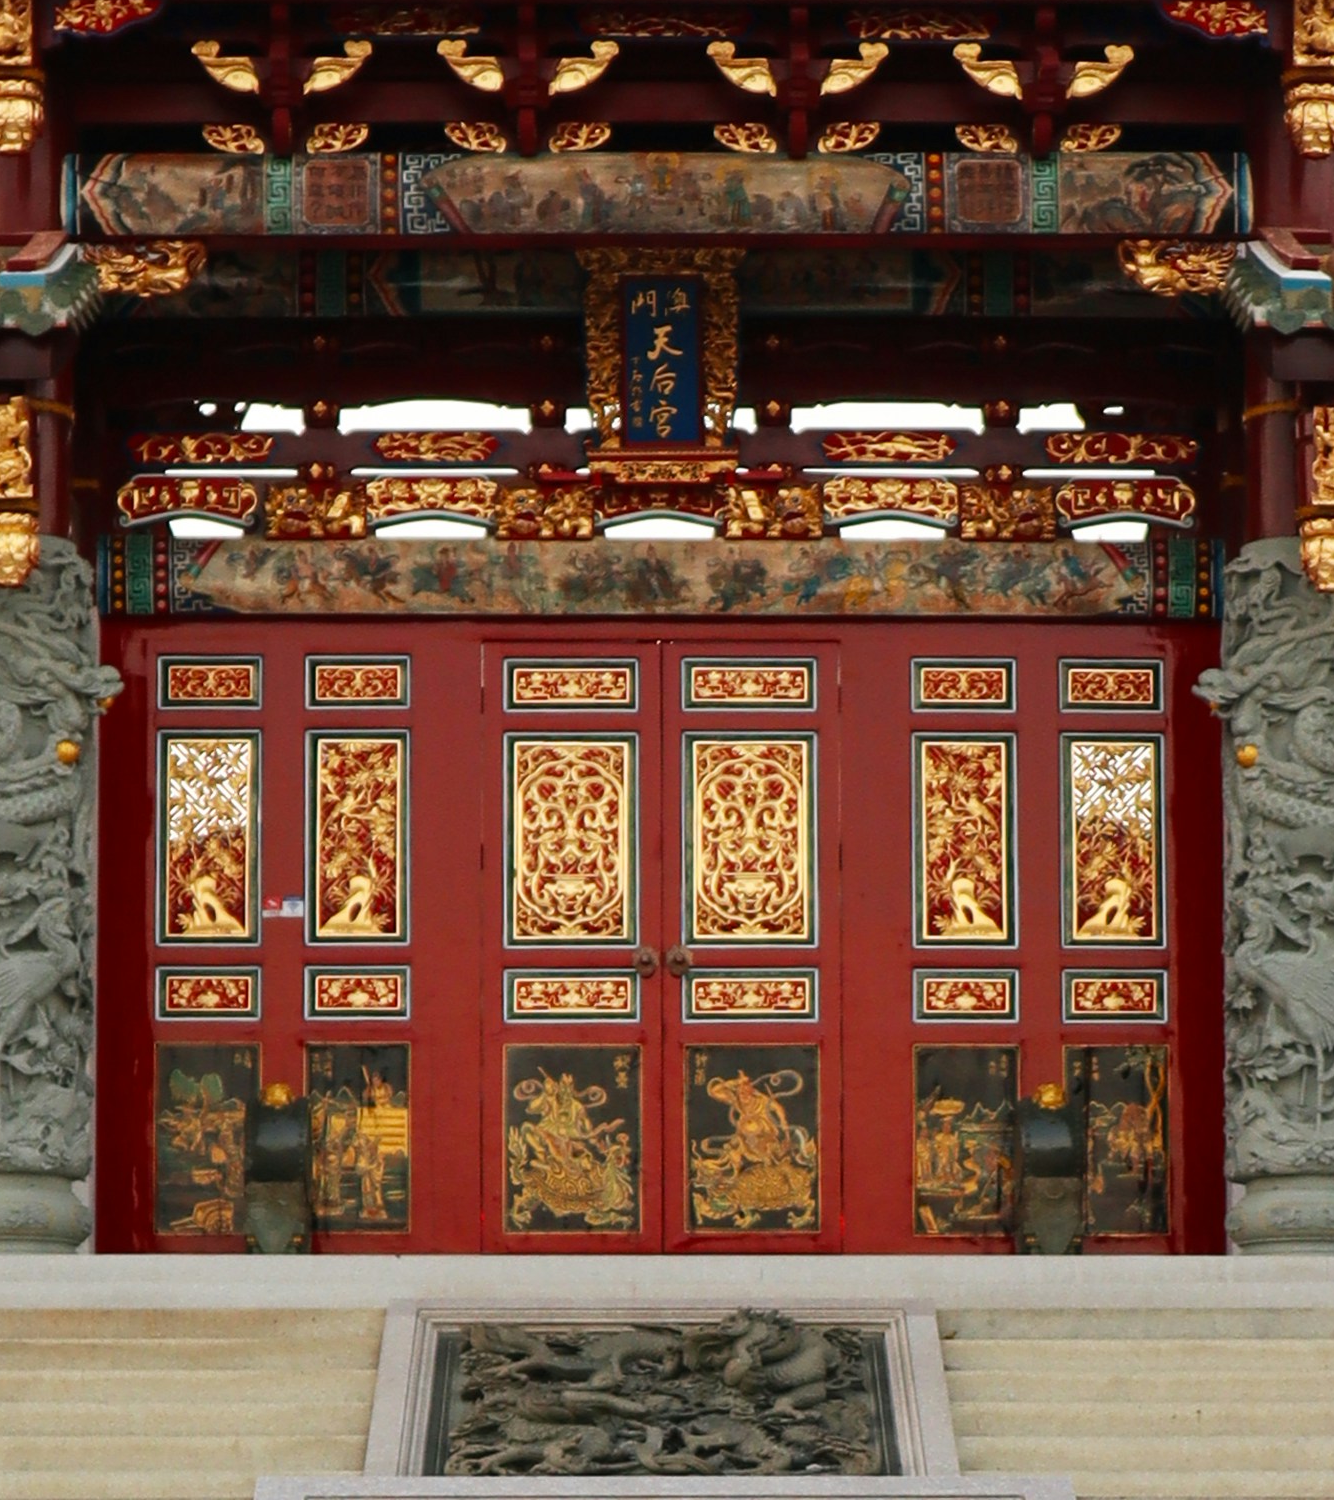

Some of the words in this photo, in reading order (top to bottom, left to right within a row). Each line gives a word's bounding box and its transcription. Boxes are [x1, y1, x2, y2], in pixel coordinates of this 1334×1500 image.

[631, 287, 691, 317] 澳門
[647, 324, 684, 439] 天后宮
